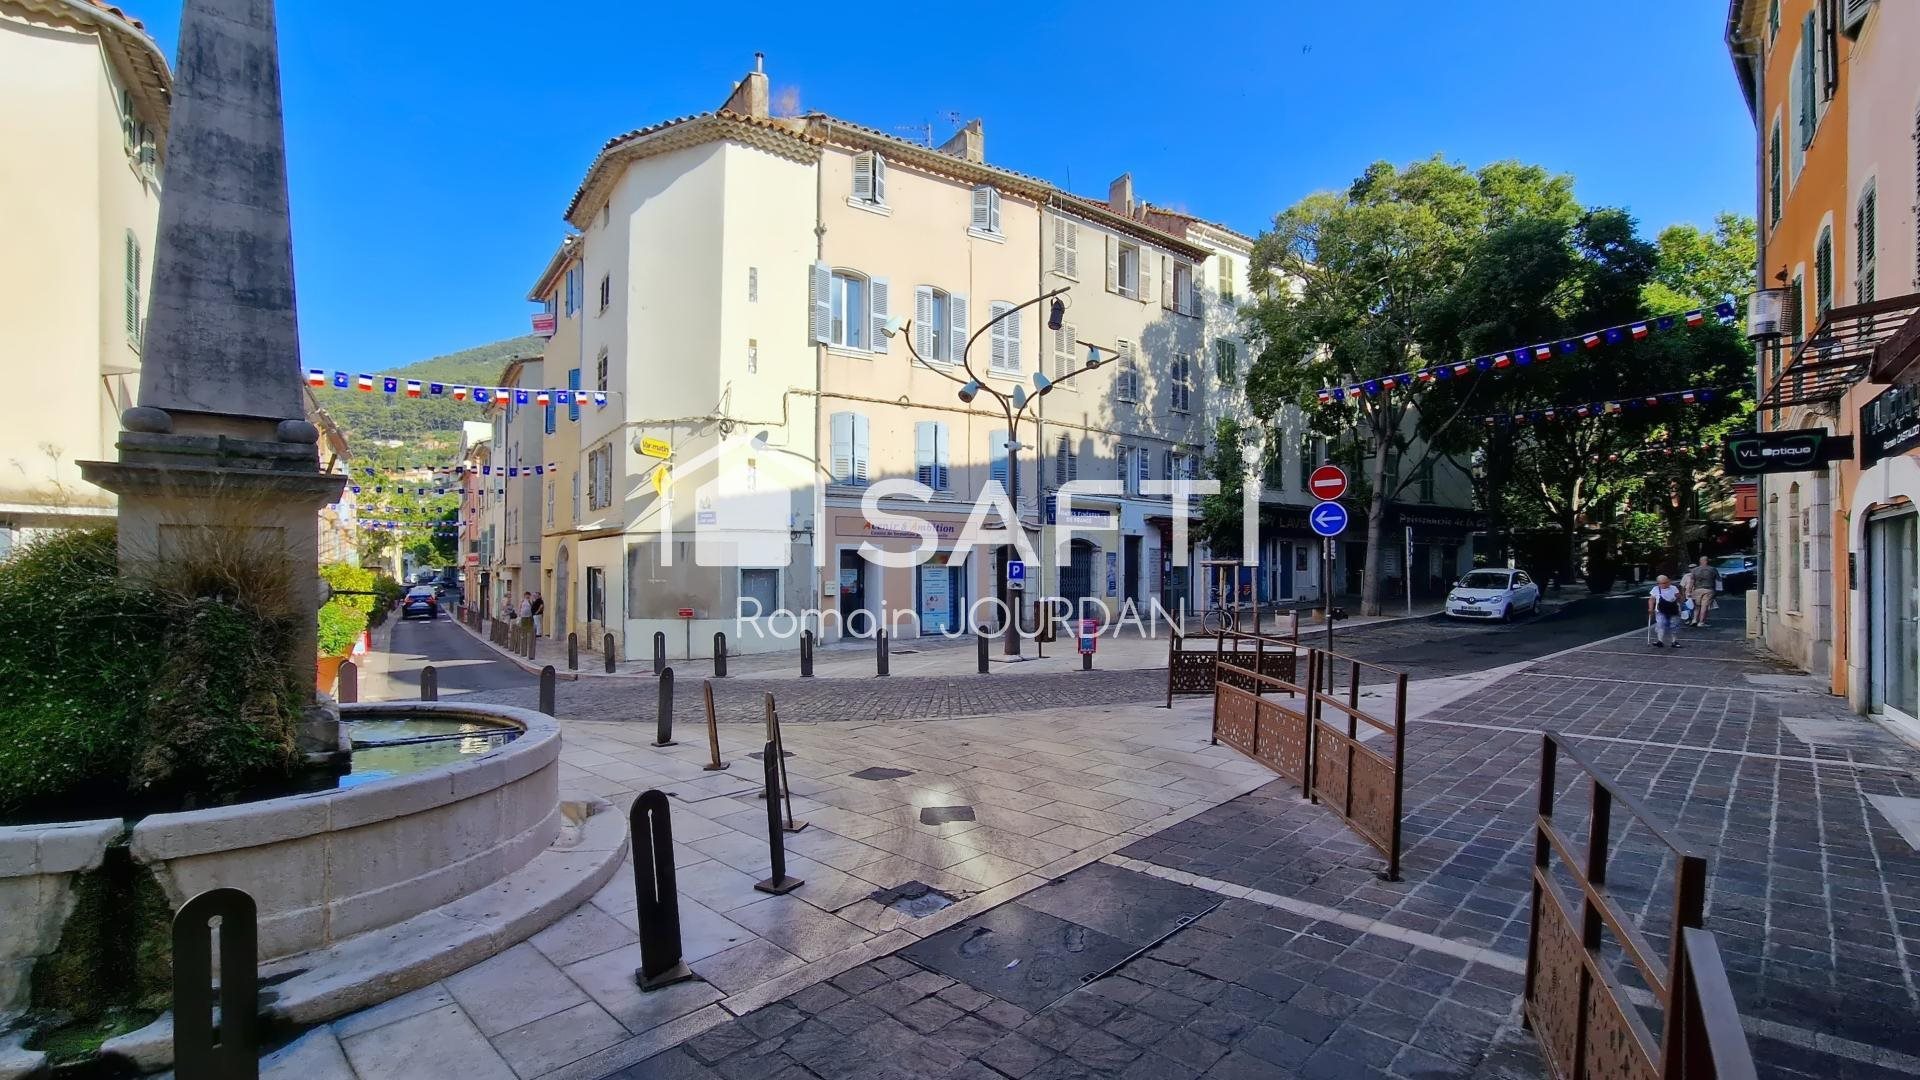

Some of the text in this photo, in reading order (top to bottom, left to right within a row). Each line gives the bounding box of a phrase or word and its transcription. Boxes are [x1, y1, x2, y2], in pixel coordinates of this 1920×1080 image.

[1740, 446, 1811, 457] VL Optique
[1012, 565, 1020, 577] P
